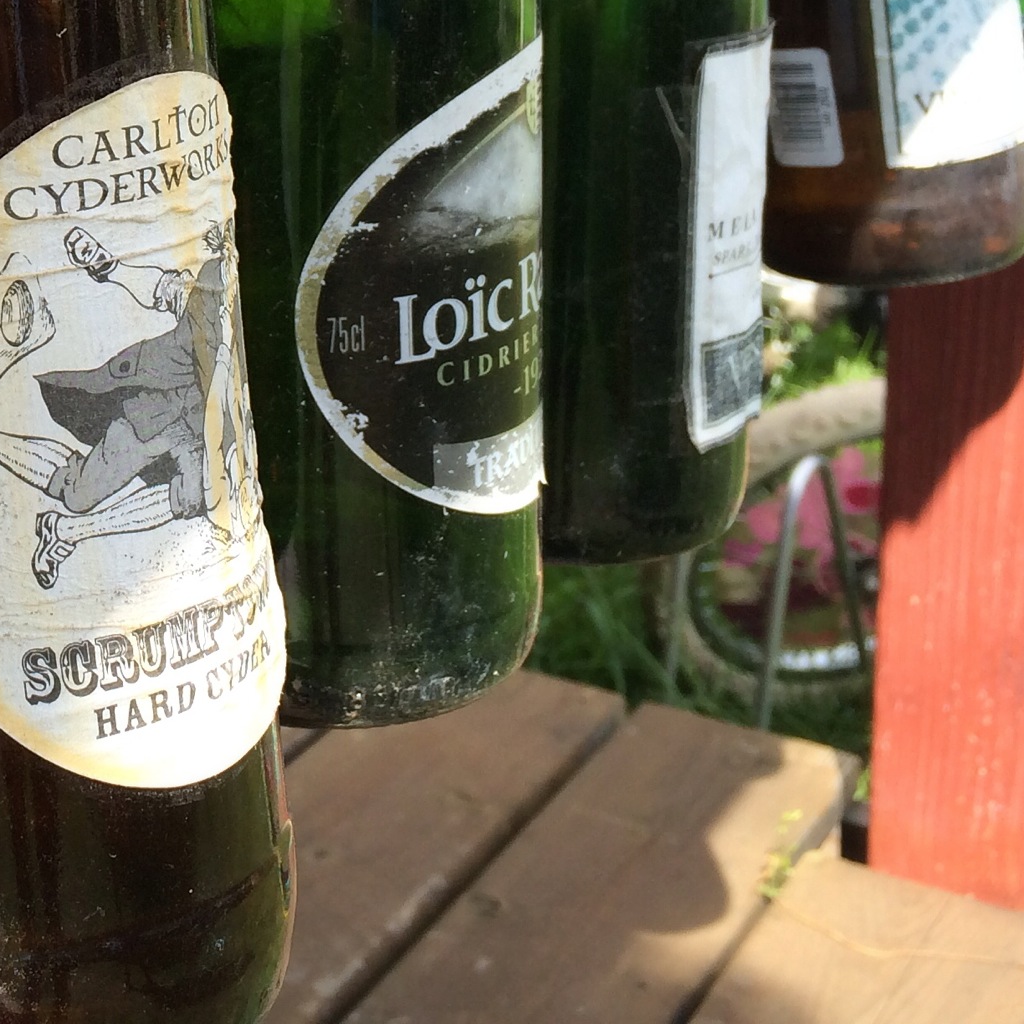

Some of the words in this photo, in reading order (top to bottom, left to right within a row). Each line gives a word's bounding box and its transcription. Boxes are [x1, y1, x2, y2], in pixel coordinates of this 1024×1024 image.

[51, 94, 221, 170] CARLTON
[327, 315, 366, 354] 75cl
[393, 273, 514, 365] Loïc
[93, 680, 197, 740] HARD
